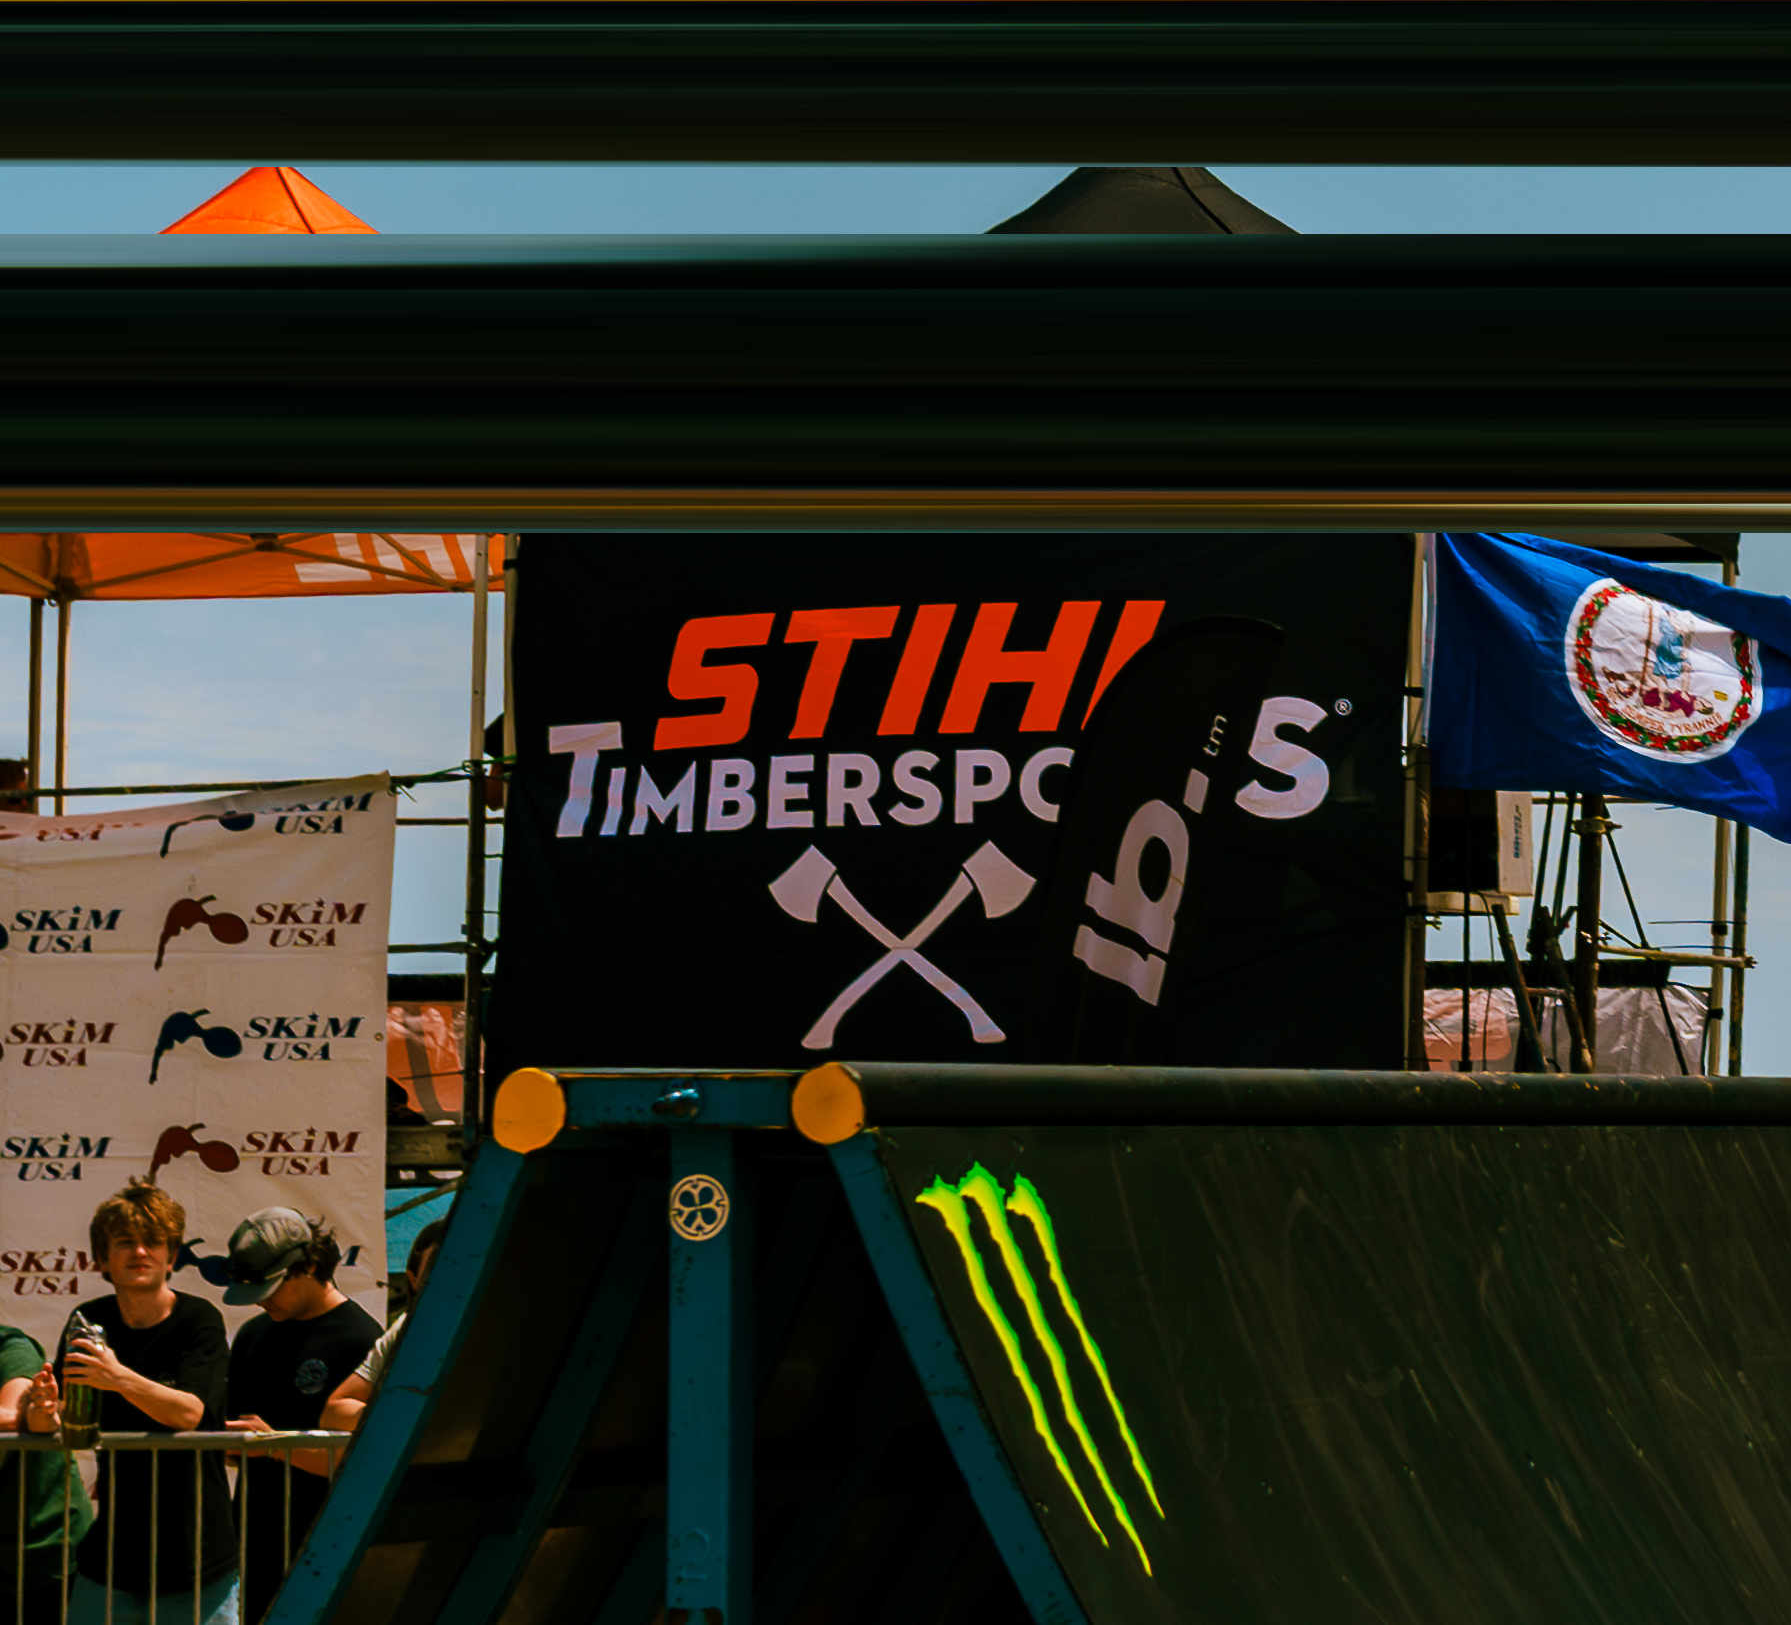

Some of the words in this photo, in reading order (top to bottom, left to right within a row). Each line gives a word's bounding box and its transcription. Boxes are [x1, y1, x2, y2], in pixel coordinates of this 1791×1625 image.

[274, 815, 345, 835] USA
[28, 935, 94, 954] USA
[268, 928, 338, 948] USA
[22, 1048, 89, 1068] USA
[262, 1042, 332, 1062] USA
[17, 1162, 83, 1182] USA
[260, 1156, 332, 1176] USA
[14, 1276, 80, 1297] USA
